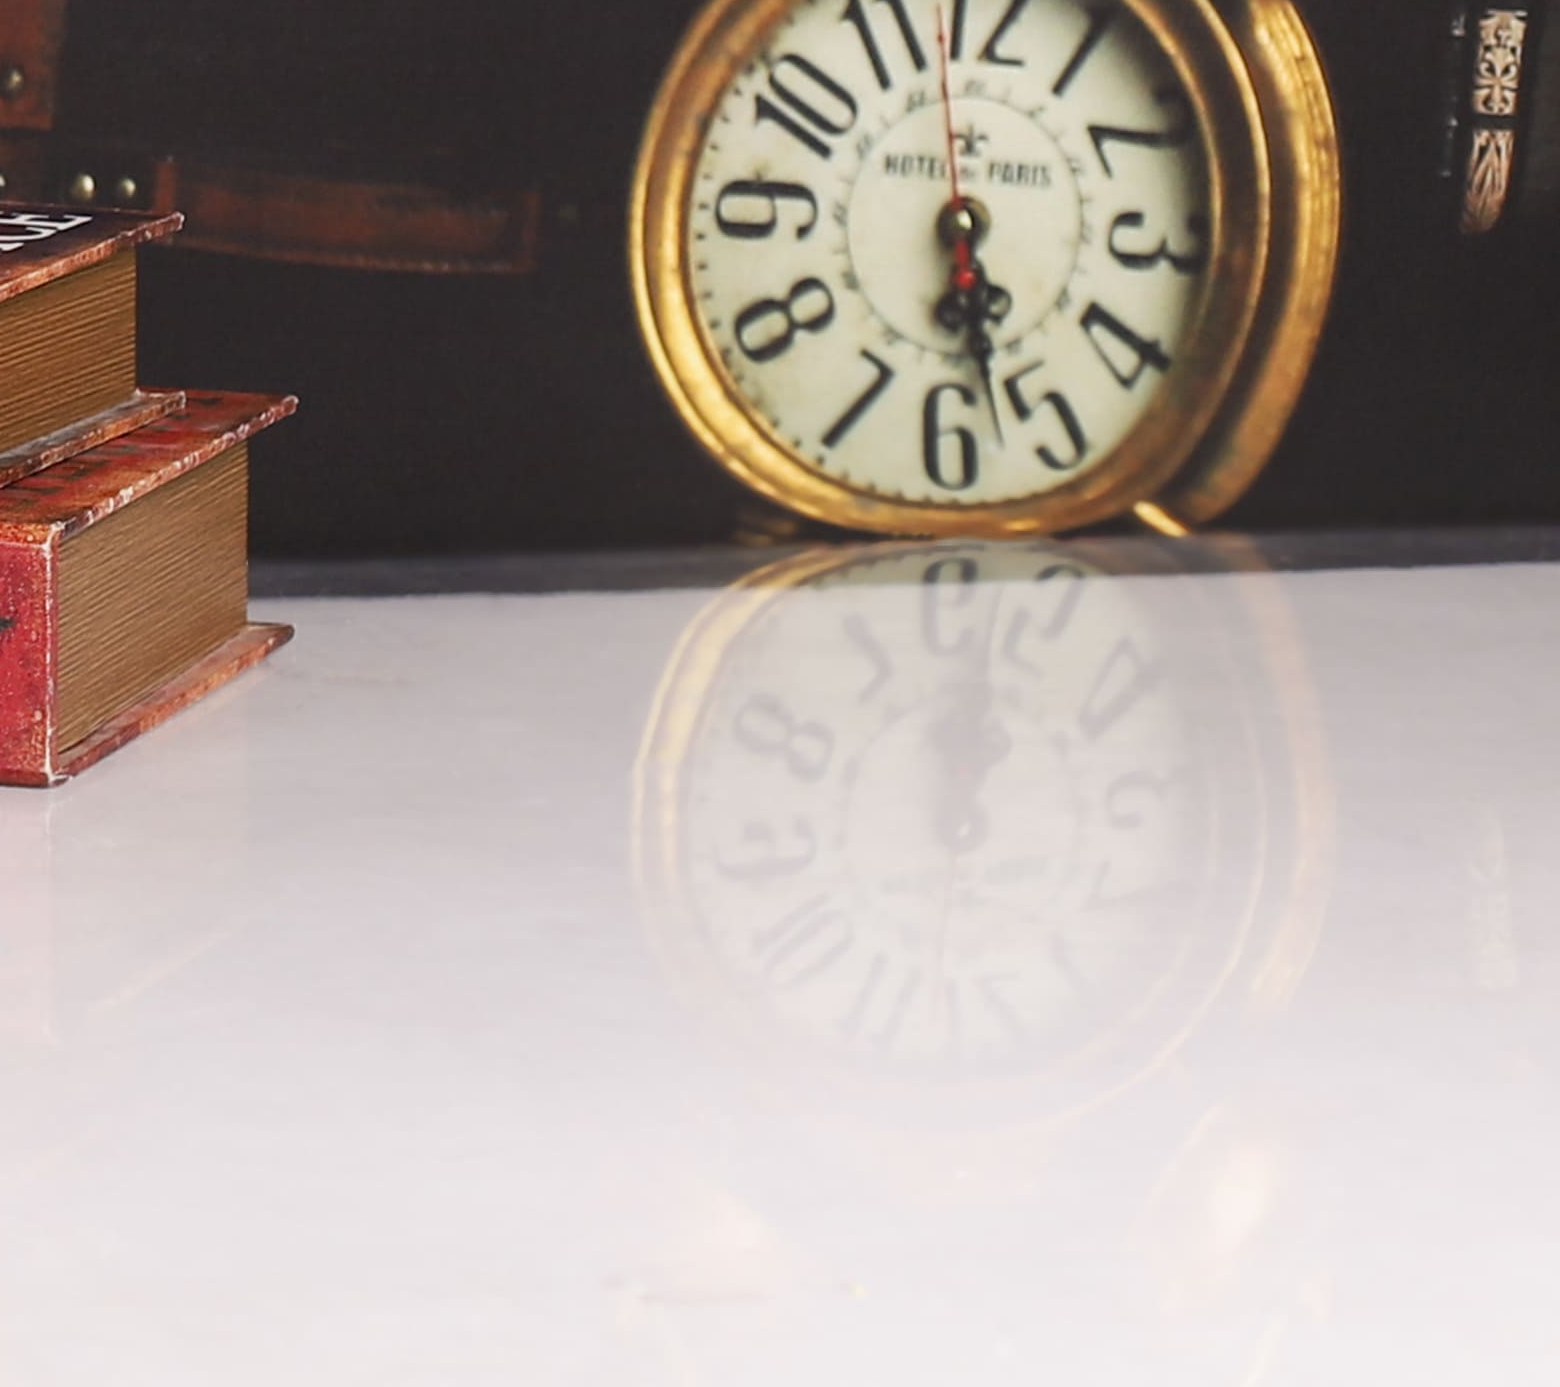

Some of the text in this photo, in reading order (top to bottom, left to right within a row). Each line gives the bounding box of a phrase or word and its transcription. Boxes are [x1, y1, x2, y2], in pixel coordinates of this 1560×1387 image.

[755, 53, 858, 159] 10
[714, 178, 818, 242] 9
[988, 161, 1052, 186] PARIS
[1107, 209, 1207, 275] 3
[733, 276, 836, 364] 8
[1080, 300, 1172, 389] 4
[822, 348, 896, 449] 7
[922, 382, 980, 492] 6
[1003, 358, 1088, 470] 5
